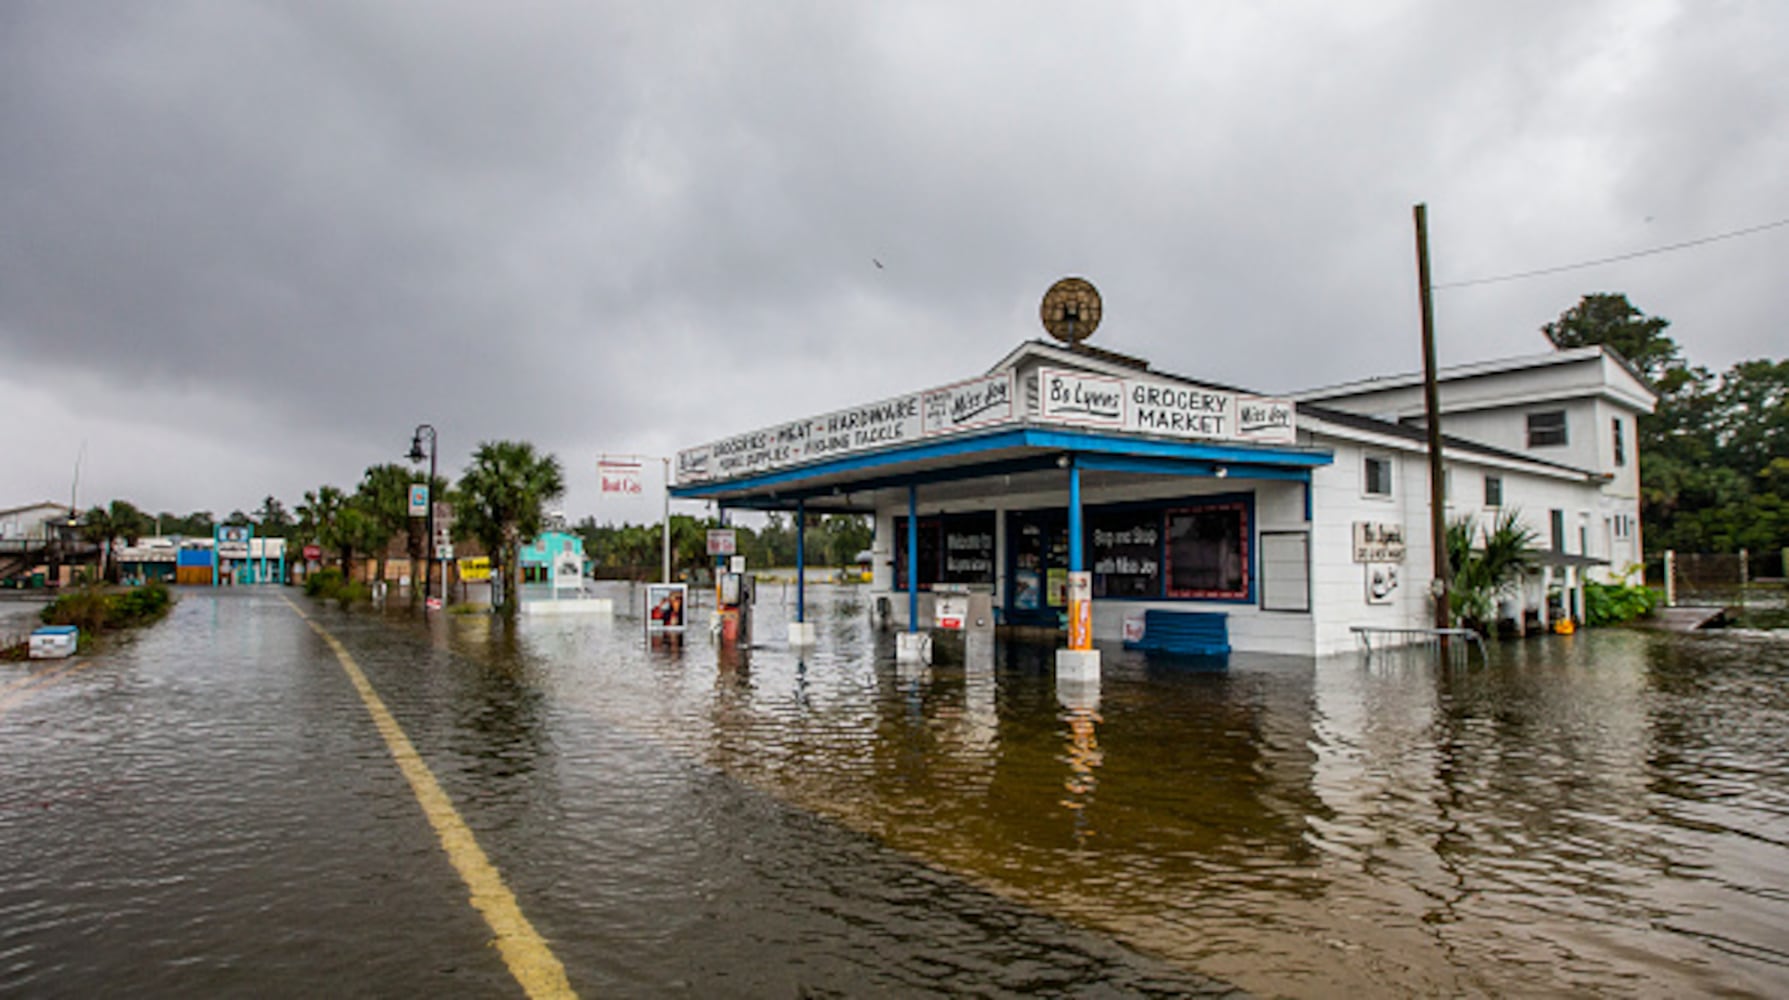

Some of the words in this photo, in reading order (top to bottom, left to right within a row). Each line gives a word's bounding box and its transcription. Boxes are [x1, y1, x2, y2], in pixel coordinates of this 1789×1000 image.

[1132, 385, 1226, 414] GROCERY
[778, 420, 813, 444] MEAT
[828, 397, 918, 434] HARDWARE
[1138, 410, 1225, 434] MARKET
[1241, 406, 1265, 423] Miss
[1267, 404, 1290, 426] Joy
[855, 421, 904, 446] TACKLE
